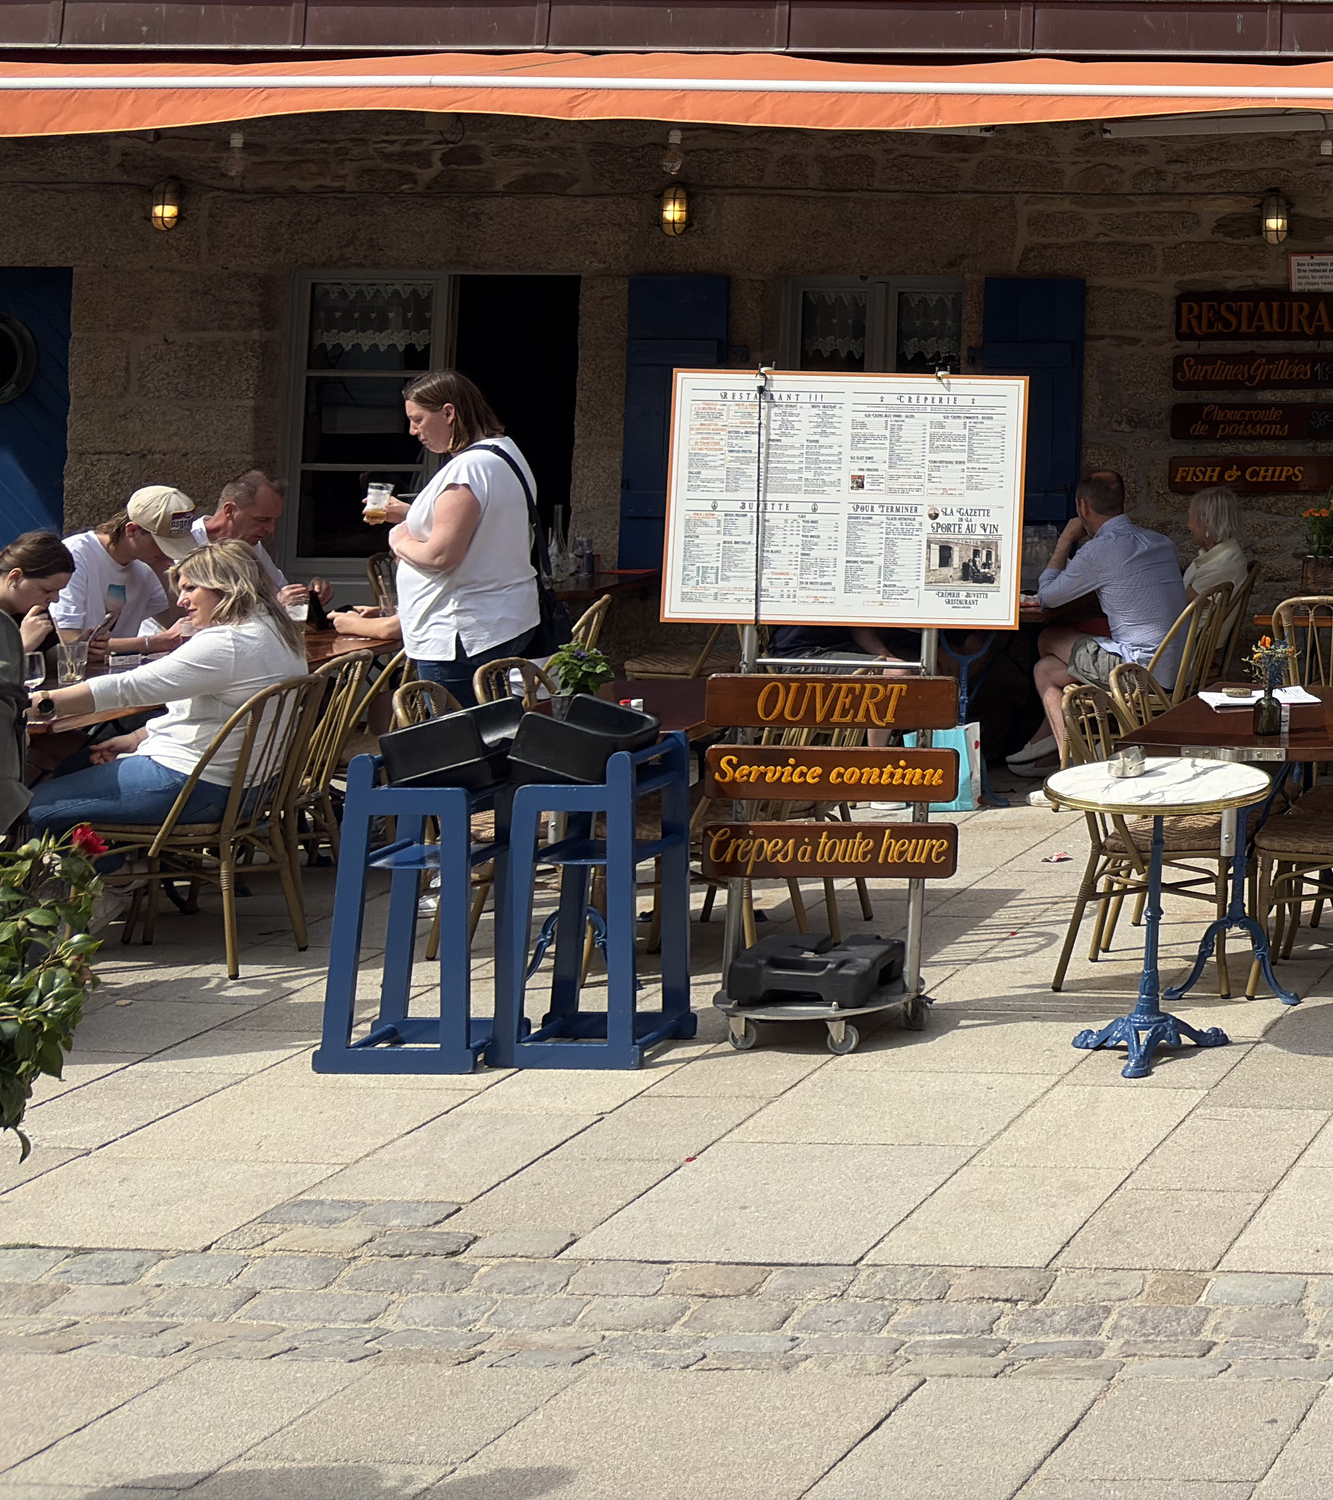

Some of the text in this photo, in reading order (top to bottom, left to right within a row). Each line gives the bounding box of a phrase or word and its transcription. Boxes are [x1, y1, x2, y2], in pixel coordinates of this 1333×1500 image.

[1177, 357, 1249, 381] Sardines
[1244, 358, 1312, 386] Grillées
[1202, 405, 1284, 421] Choucroute
[1190, 421, 1289, 438] de poissons
[1175, 464, 1305, 482] FISH & CHIPS
[739, 502, 790, 512] BUETTE
[852, 504, 919, 514] POUR TERMINER
[956, 508, 991, 518] GAZETTE
[930, 522, 999, 534] PORTE AU VIN
[756, 681, 908, 727] OUVERT
[714, 755, 944, 787] Service continu
[797, 837, 812, 863] à
[816, 830, 875, 863] toute
[878, 828, 949, 864] heure
